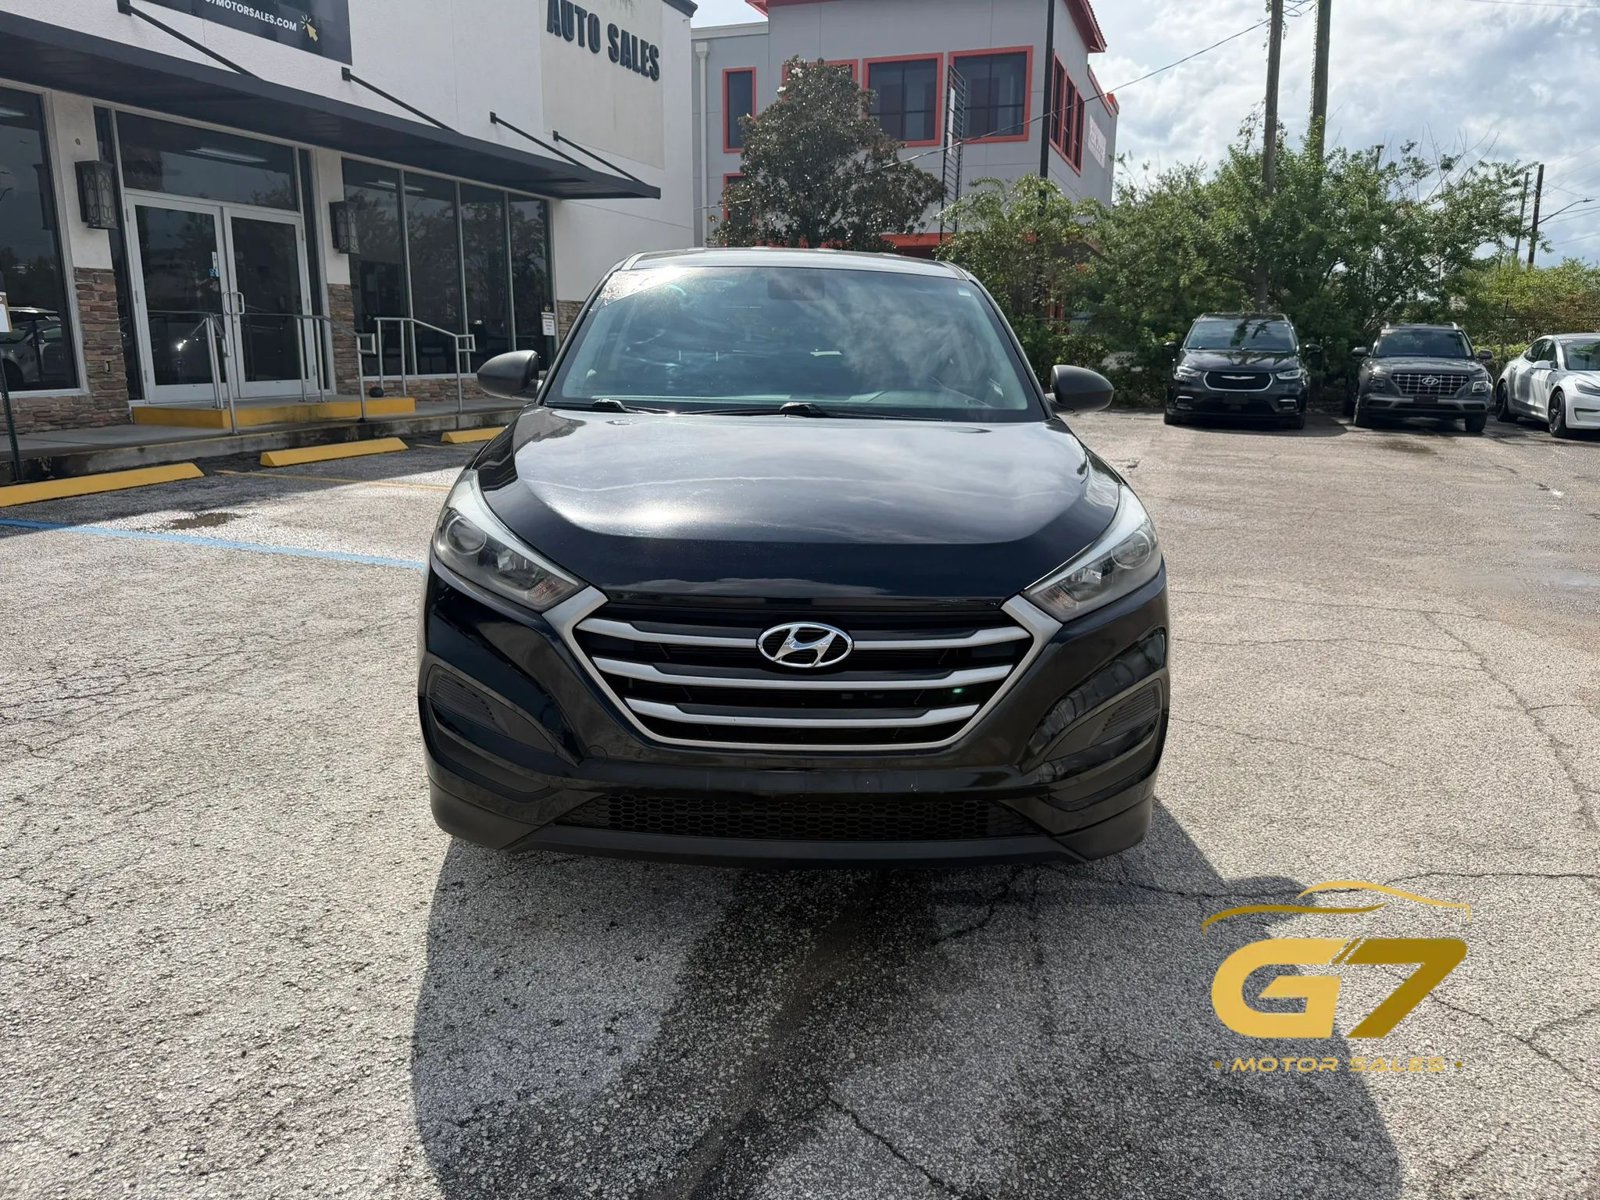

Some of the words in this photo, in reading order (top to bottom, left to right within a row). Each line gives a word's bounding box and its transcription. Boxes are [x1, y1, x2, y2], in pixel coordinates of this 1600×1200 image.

[205, 0, 297, 31] MOTORSALES.COM
[547, 0, 601, 53] AUTO
[607, 23, 660, 81] SALES
